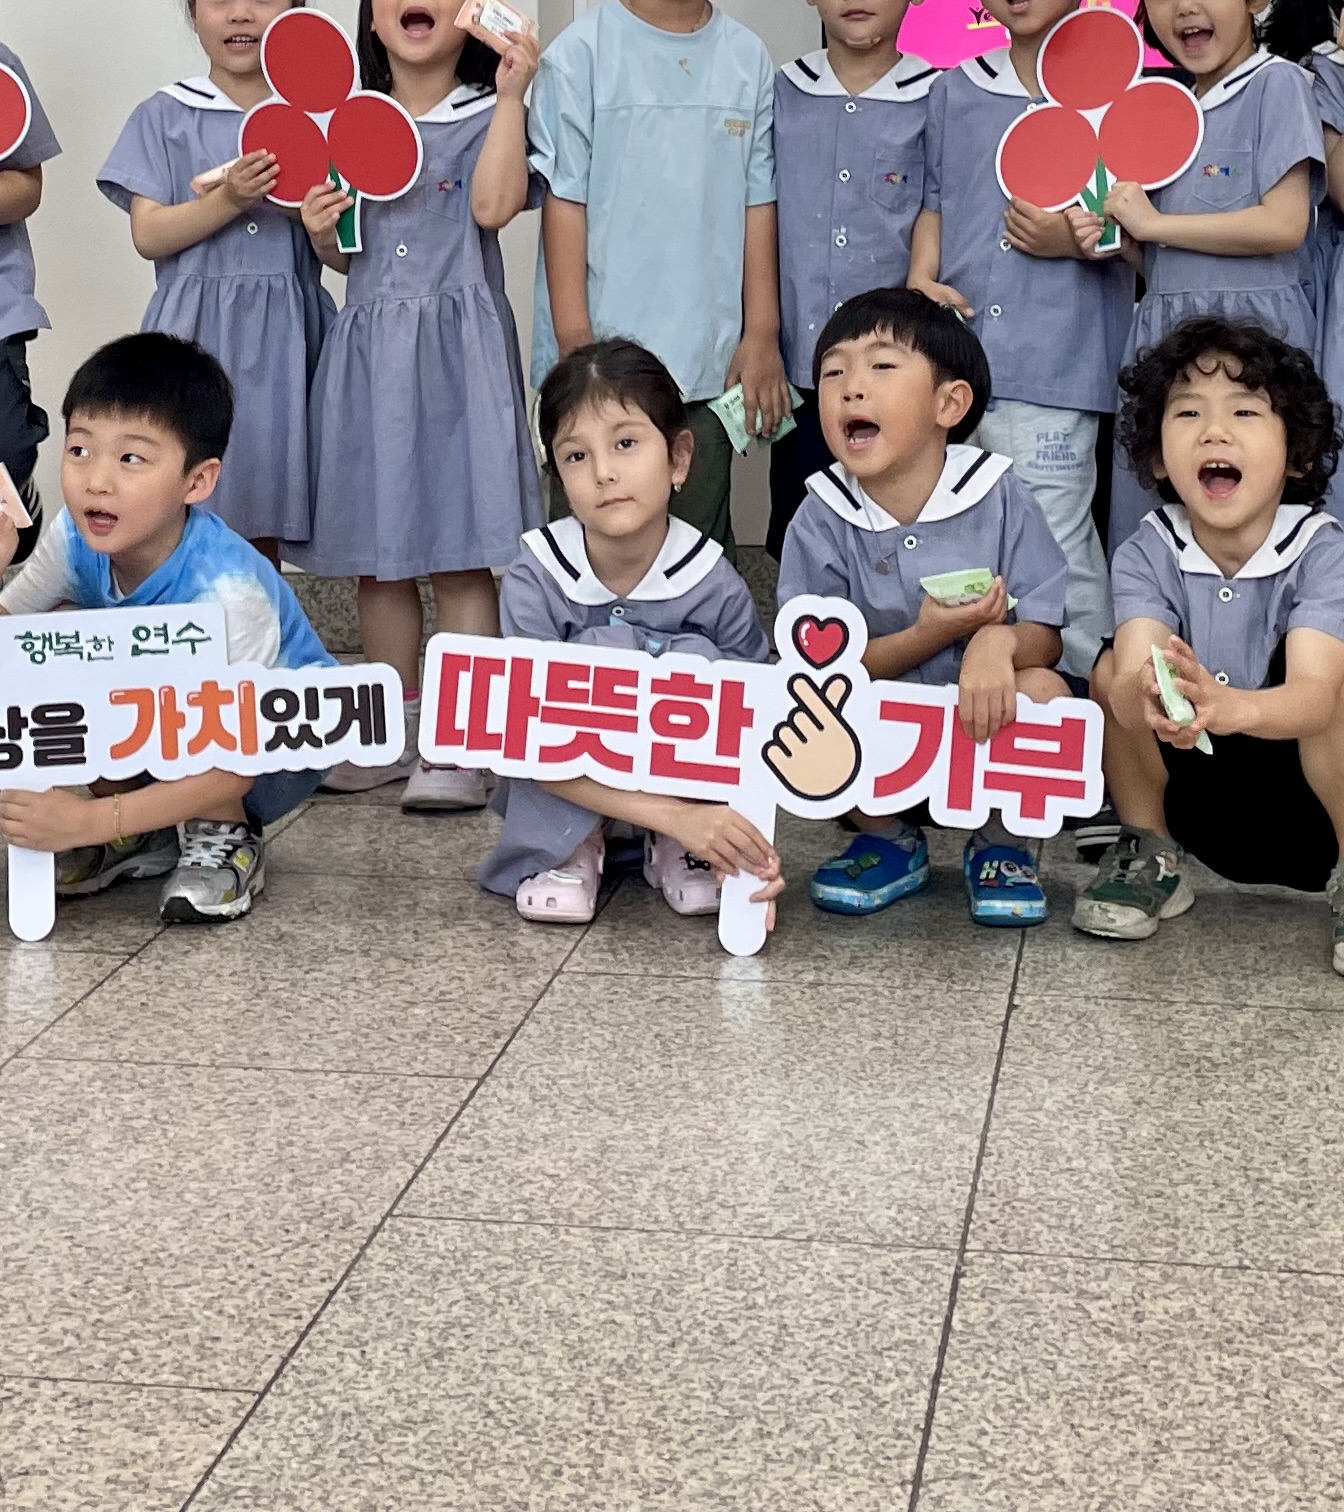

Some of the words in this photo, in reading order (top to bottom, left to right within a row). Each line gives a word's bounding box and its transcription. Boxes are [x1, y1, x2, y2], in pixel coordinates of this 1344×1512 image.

[1036, 451, 1077, 461] FRIEND
[14, 630, 115, 664] 행복한
[130, 621, 213, 656] 연수
[108, 680, 387, 760] 가치있게
[434, 653, 753, 785] 따뜻한
[874, 700, 1086, 821] 기부
